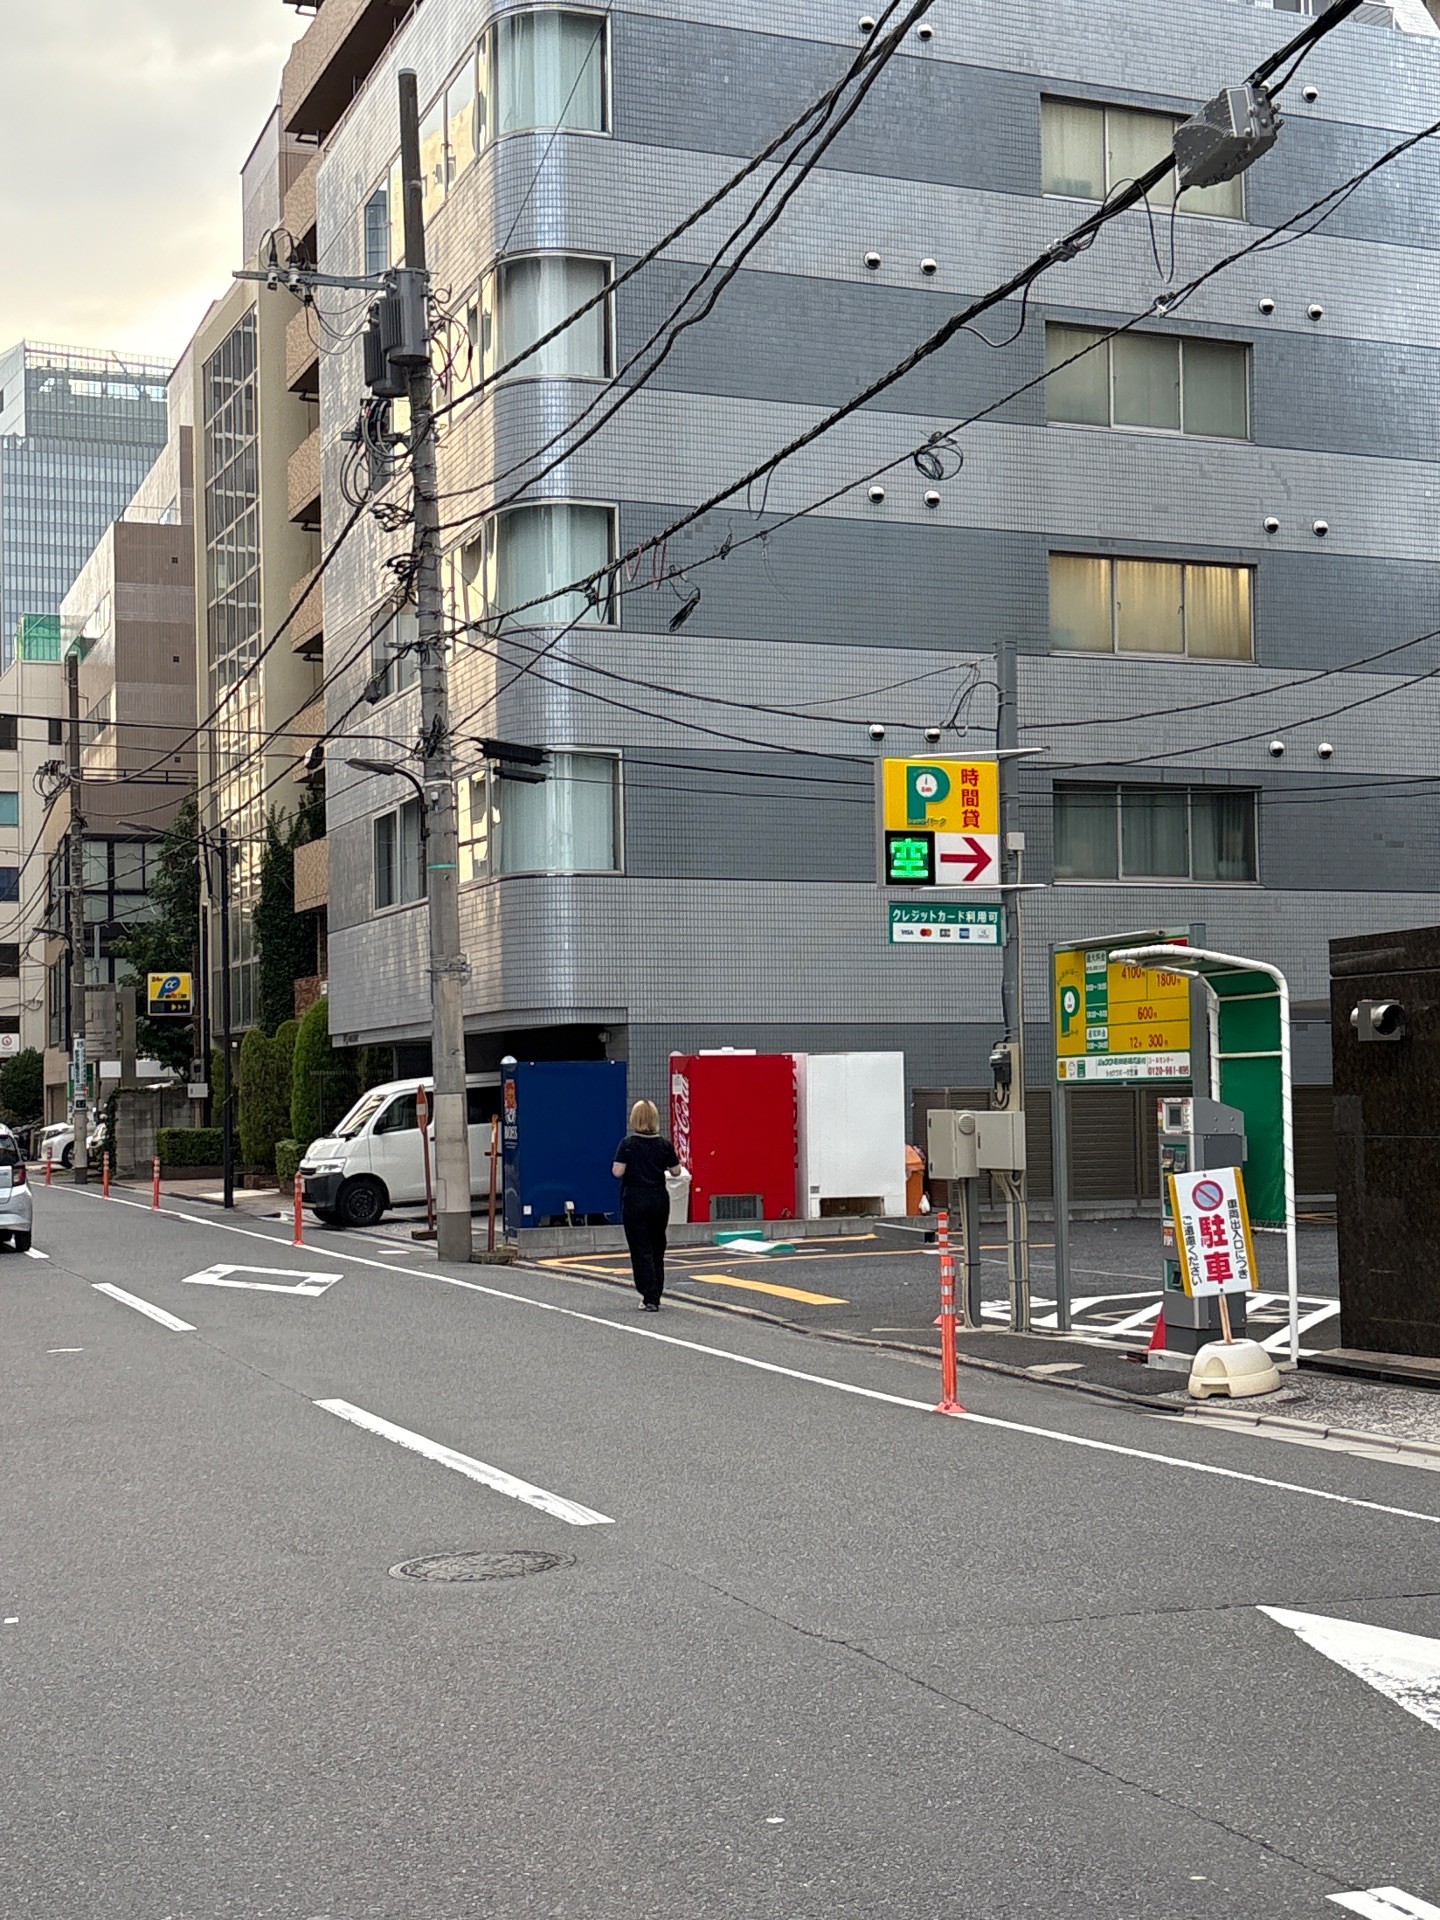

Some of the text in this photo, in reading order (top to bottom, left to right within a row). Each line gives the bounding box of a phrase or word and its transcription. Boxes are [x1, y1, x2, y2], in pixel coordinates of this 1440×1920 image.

[961, 768, 979, 828] 時間貸
[890, 837, 928, 877] 空
[892, 909, 998, 923] クレジットカード利用可
[1182, 1215, 1203, 1286] ご遠慮ください
[1199, 1214, 1234, 1285] 駐車
[1227, 1199, 1248, 1280] 車両出入口につき
